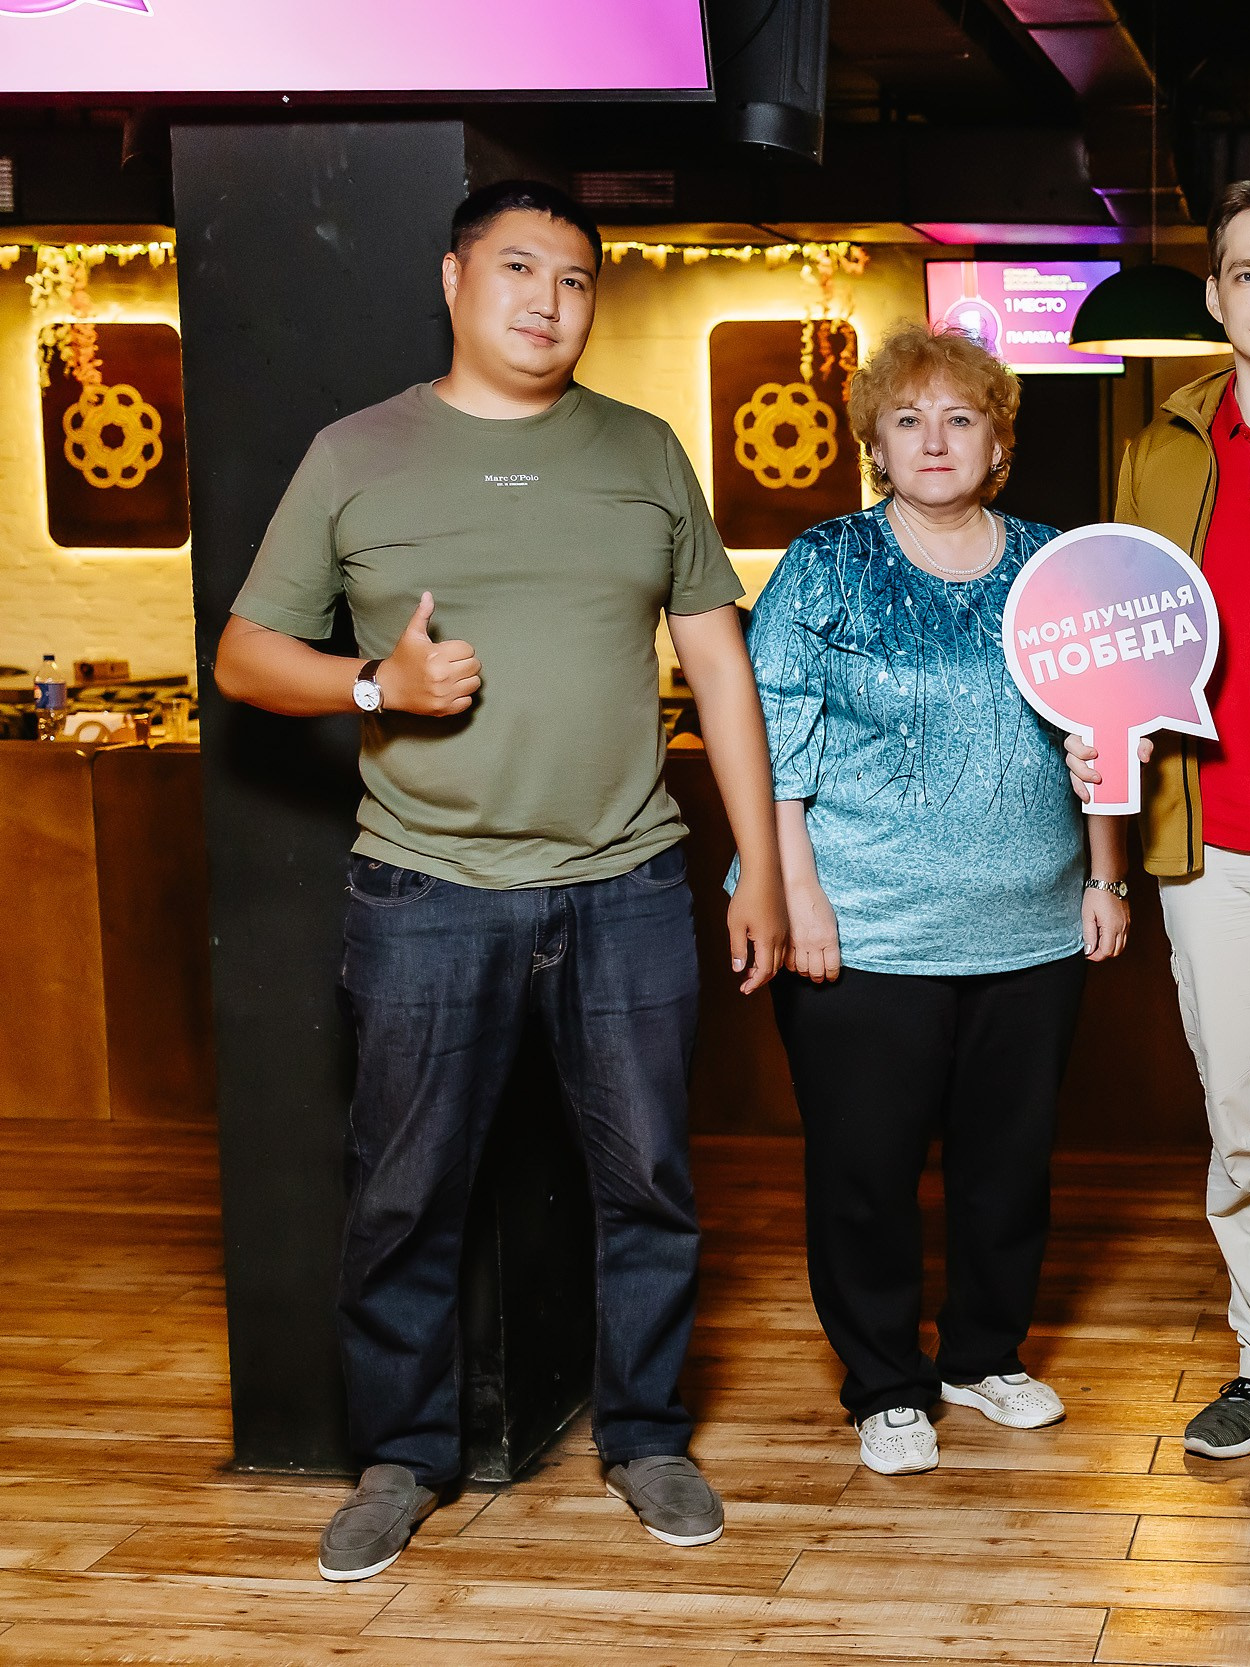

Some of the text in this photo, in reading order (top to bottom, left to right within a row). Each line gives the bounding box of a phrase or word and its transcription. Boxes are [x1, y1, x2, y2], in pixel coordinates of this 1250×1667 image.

[1004, 297, 1067, 312] 1 МЕСТО
[1006, 331, 1055, 344] ПАЛАТА
[1017, 584, 1195, 650] МОЯ ЛУЧШАЯ
[1028, 612, 1202, 685] ПОБЕДА
